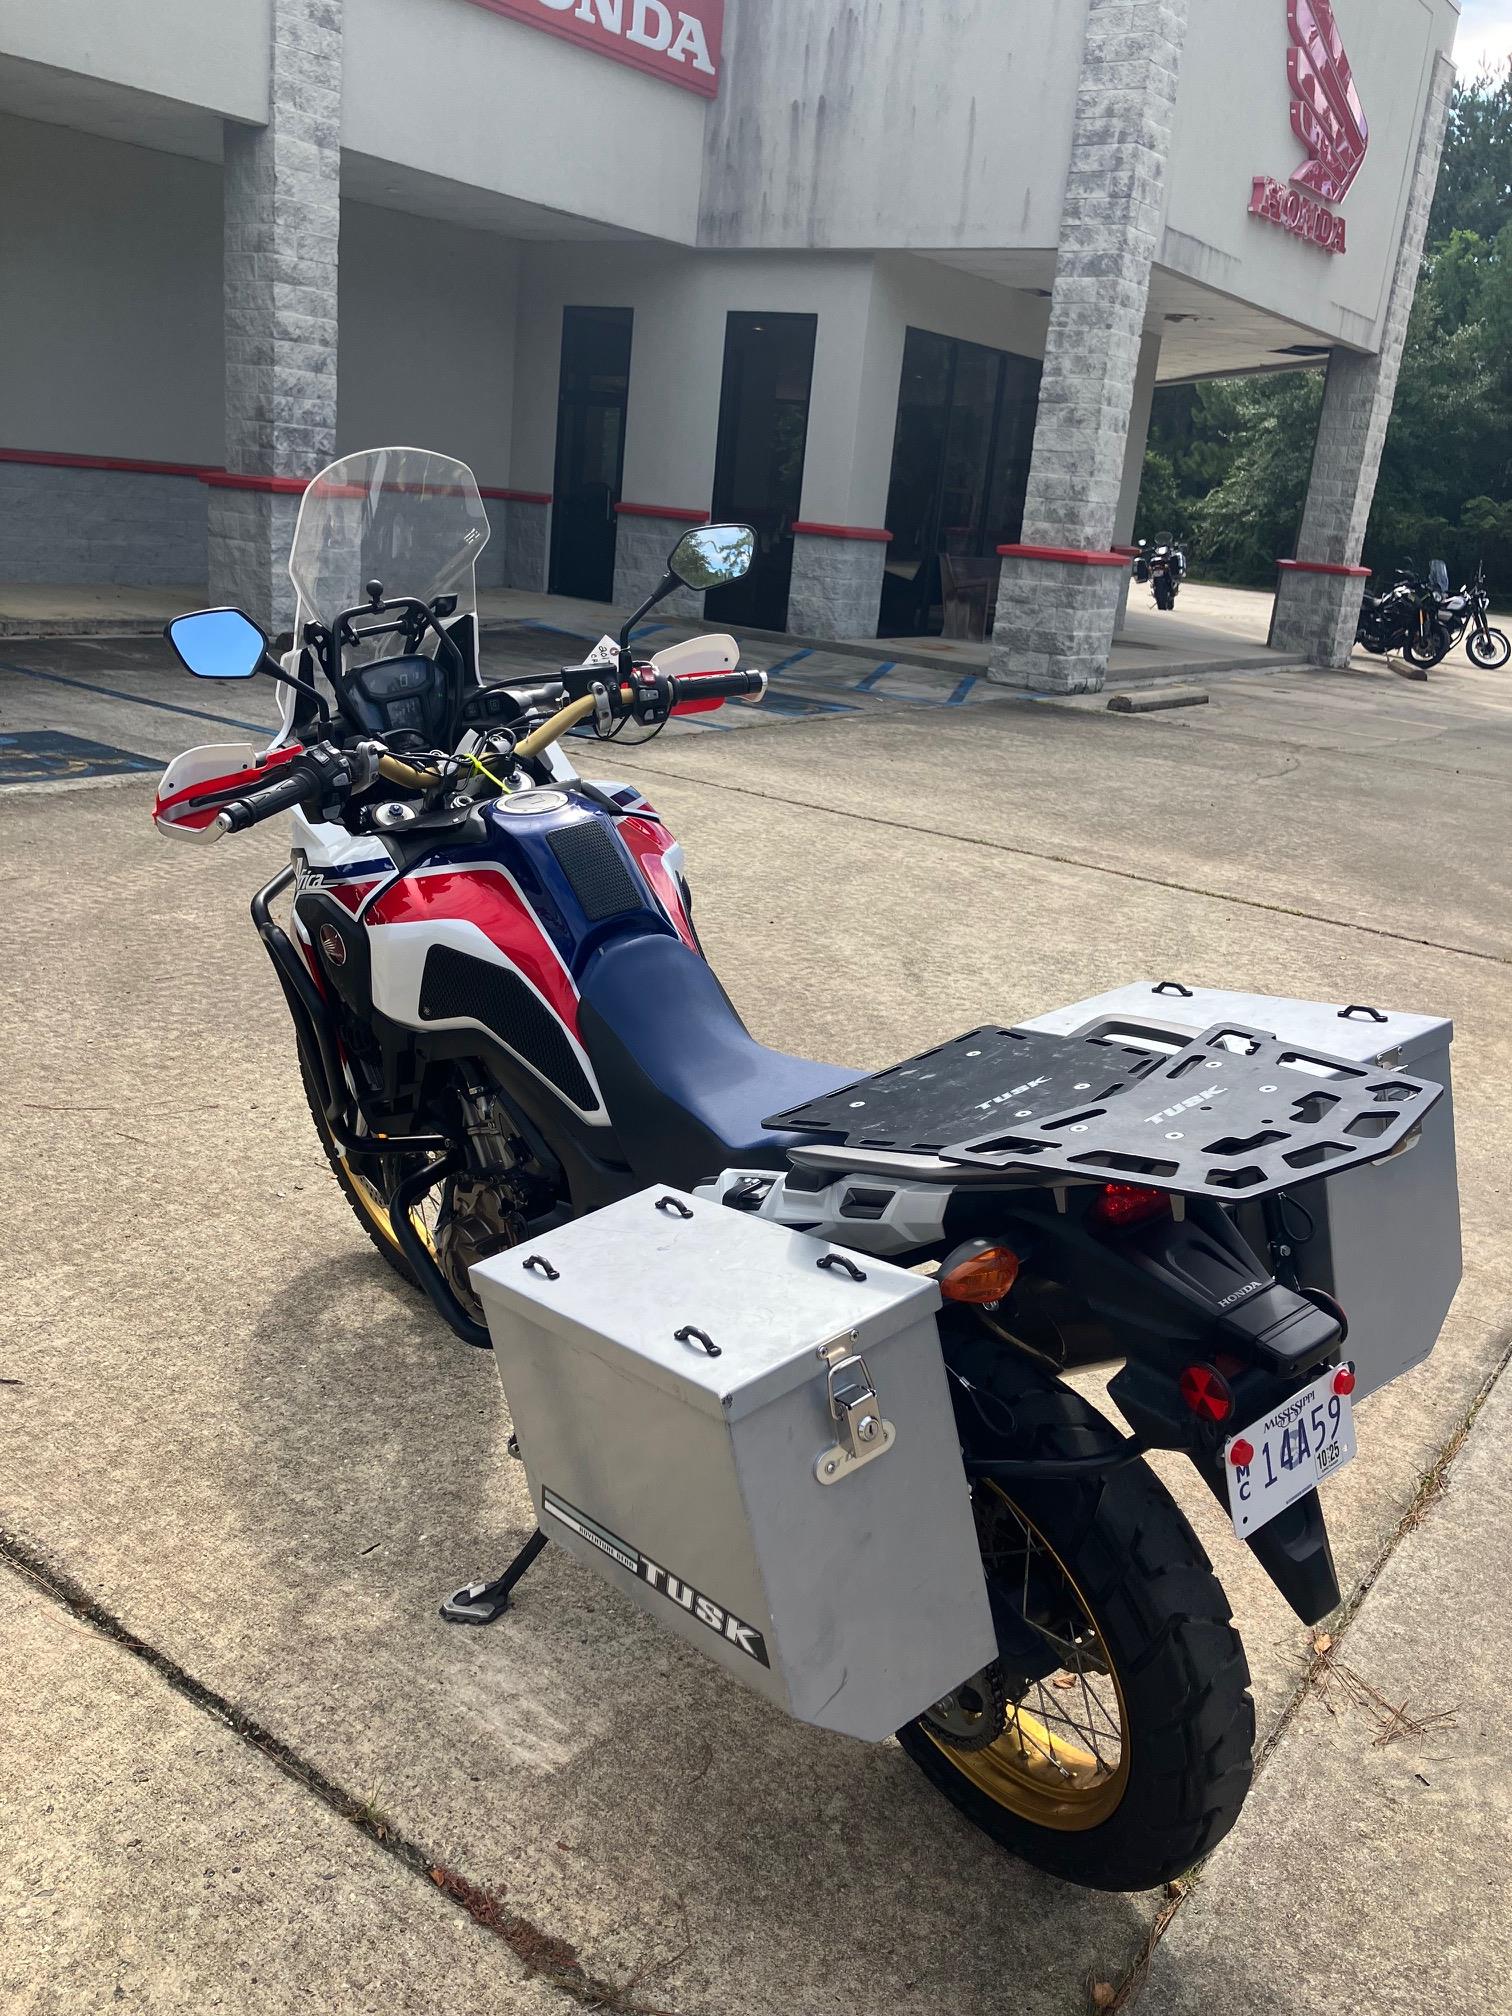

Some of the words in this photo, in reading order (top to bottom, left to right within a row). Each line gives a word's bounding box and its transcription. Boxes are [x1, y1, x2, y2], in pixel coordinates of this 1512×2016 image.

[538, 0, 716, 76] NDA
[1248, 176, 1346, 254] HONDA
[974, 1075, 1052, 1110] TUSK
[1144, 1085, 1228, 1125] TUSK
[1217, 1281, 1262, 1307] HONDA
[1262, 1395, 1341, 1488] 14A59
[640, 1556, 759, 1659] TUSK
